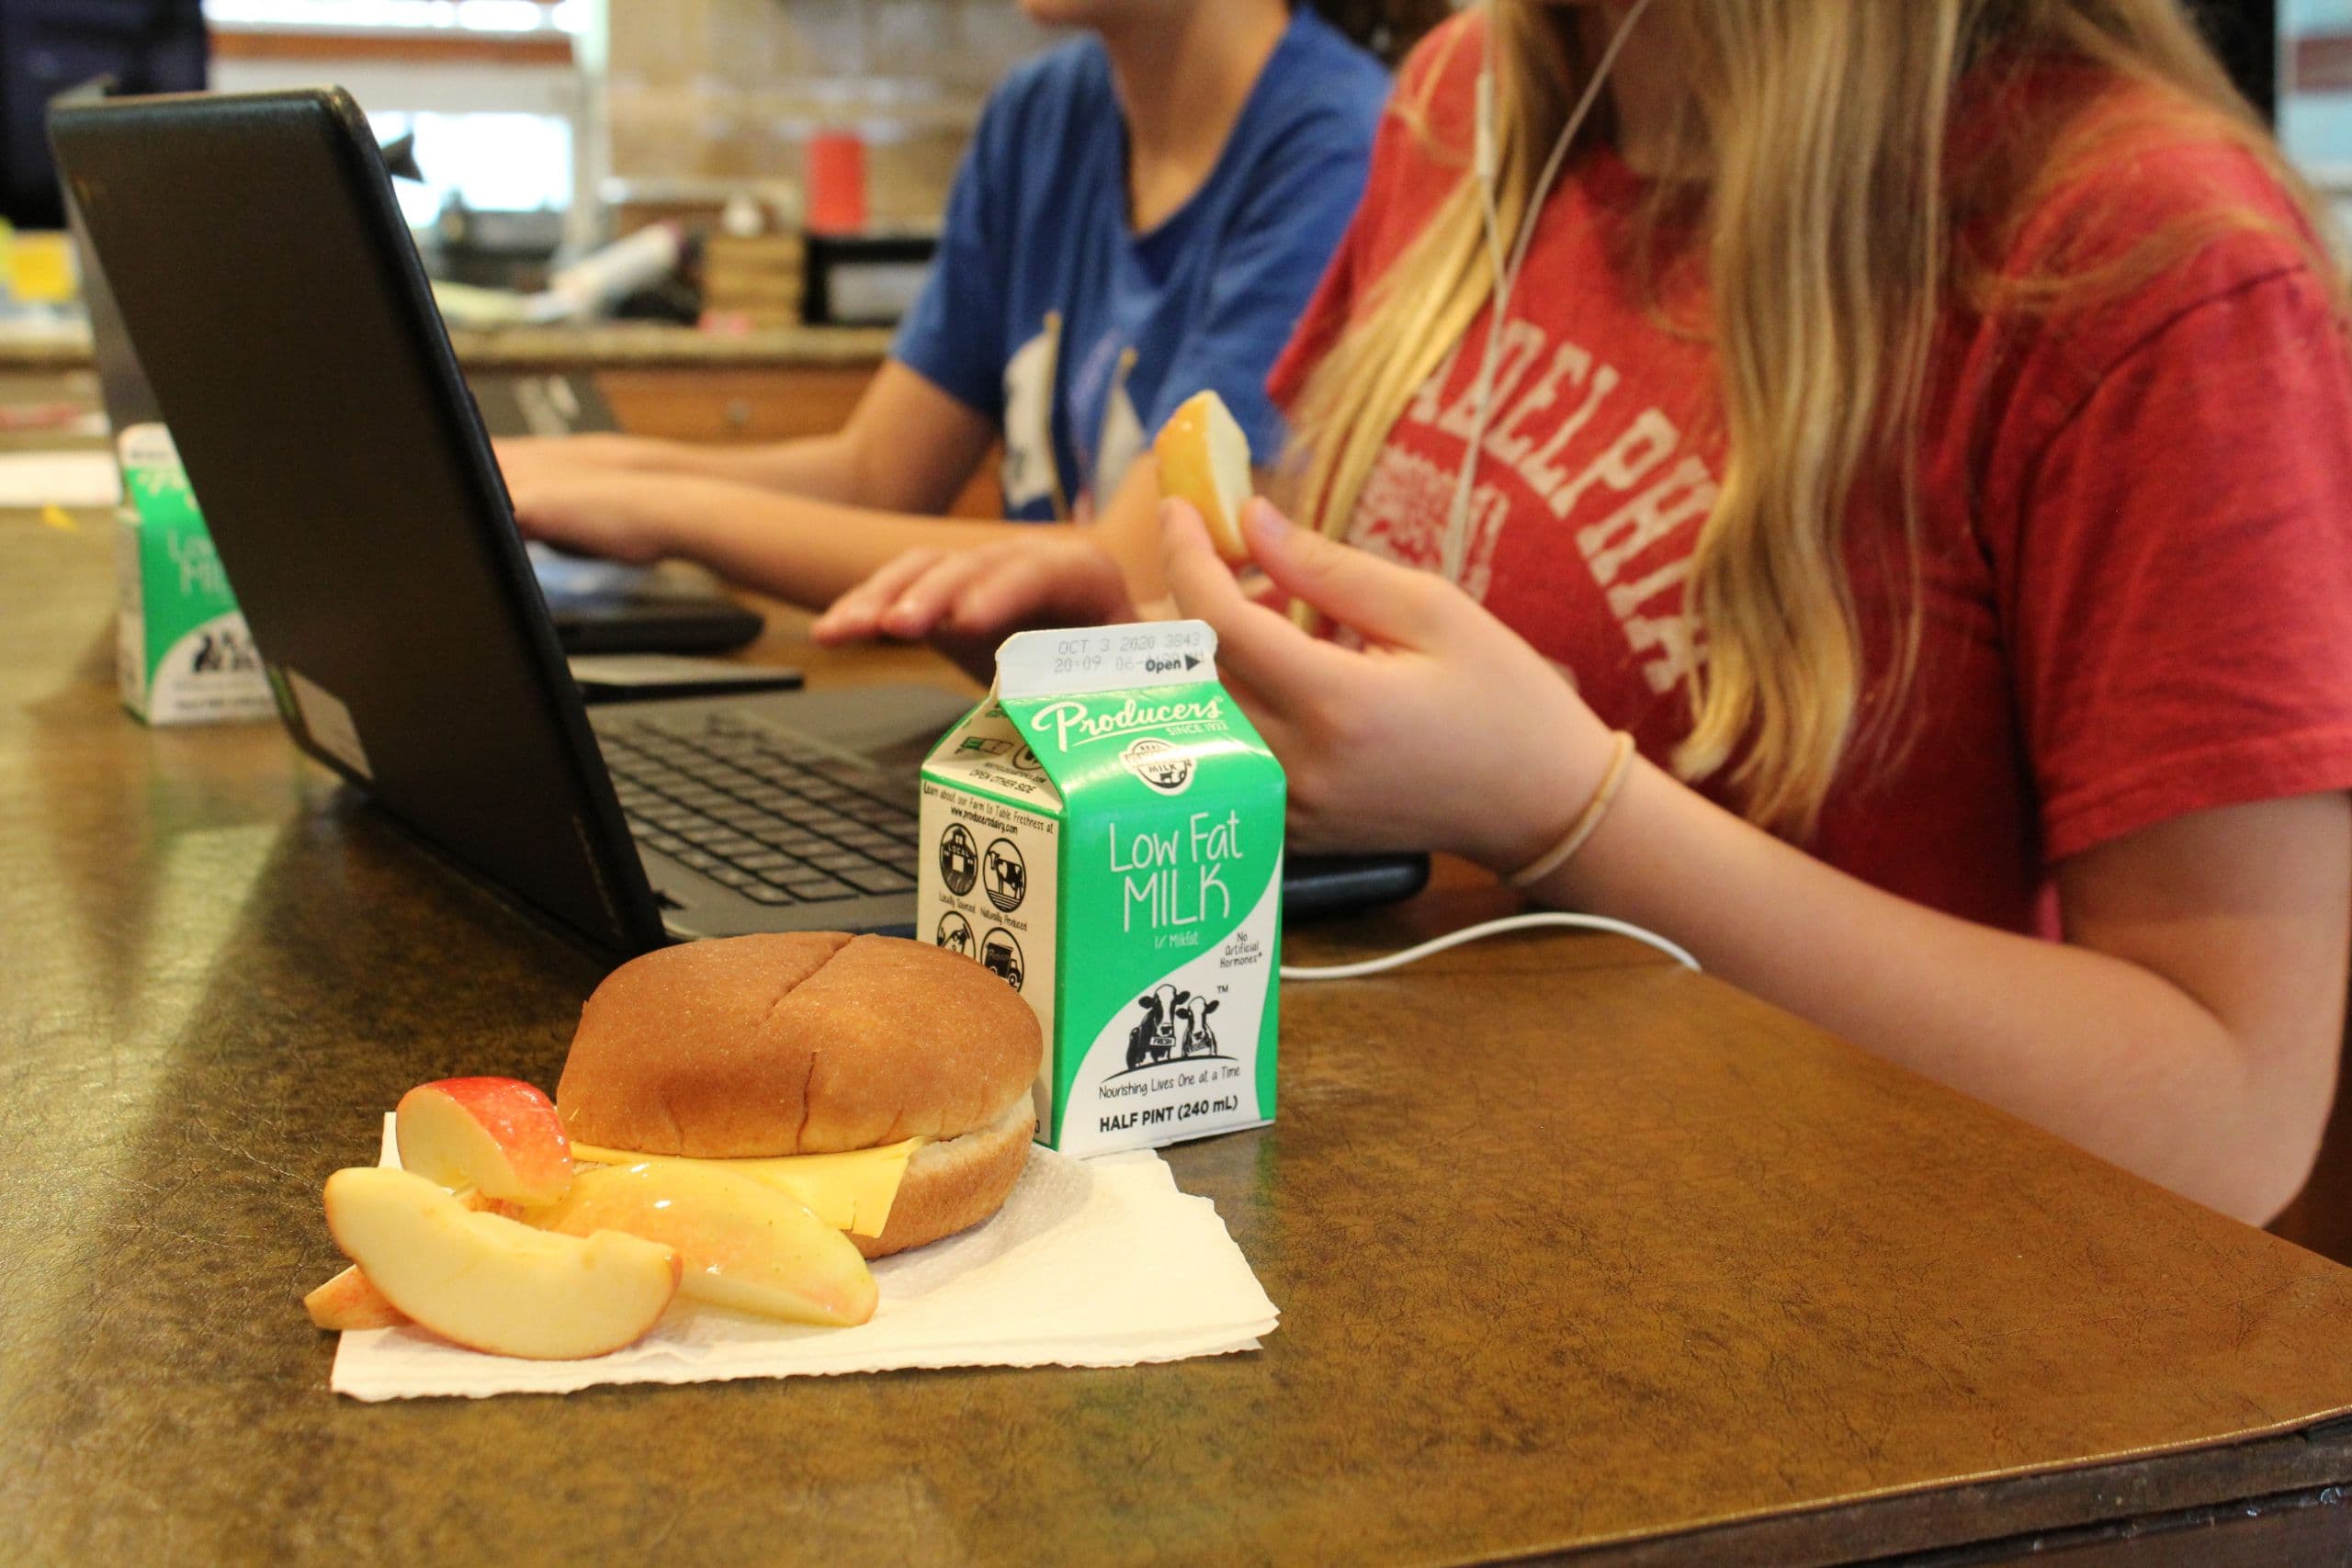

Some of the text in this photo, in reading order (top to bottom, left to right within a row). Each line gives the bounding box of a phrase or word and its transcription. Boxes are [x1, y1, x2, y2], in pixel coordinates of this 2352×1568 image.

[1058, 638, 1090, 655] OCT
[1102, 638, 1111, 653] 3
[1120, 635, 1157, 653] 2020
[1145, 659, 1182, 674] Open
[1030, 698, 1224, 753] Producers
[1165, 722, 1204, 736] SINCE
[1148, 762, 1177, 773] MILK
[922, 781, 1054, 835] Learn about our Farm to Table Freshness at
[950, 807, 1019, 835] www.producersdairy.com
[1109, 809, 1243, 872] Low Fat
[1123, 863, 1230, 933] MILK
[979, 908, 1028, 932] Naturally Produced
[1225, 941, 1260, 956] Artificial
[1237, 931, 1248, 942] No
[1216, 985, 1229, 993] TM
[1099, 1066, 1240, 1100] Nourishing Lives One at a Time
[1100, 1094, 1238, 1133] HALF PINT (240 mL)
